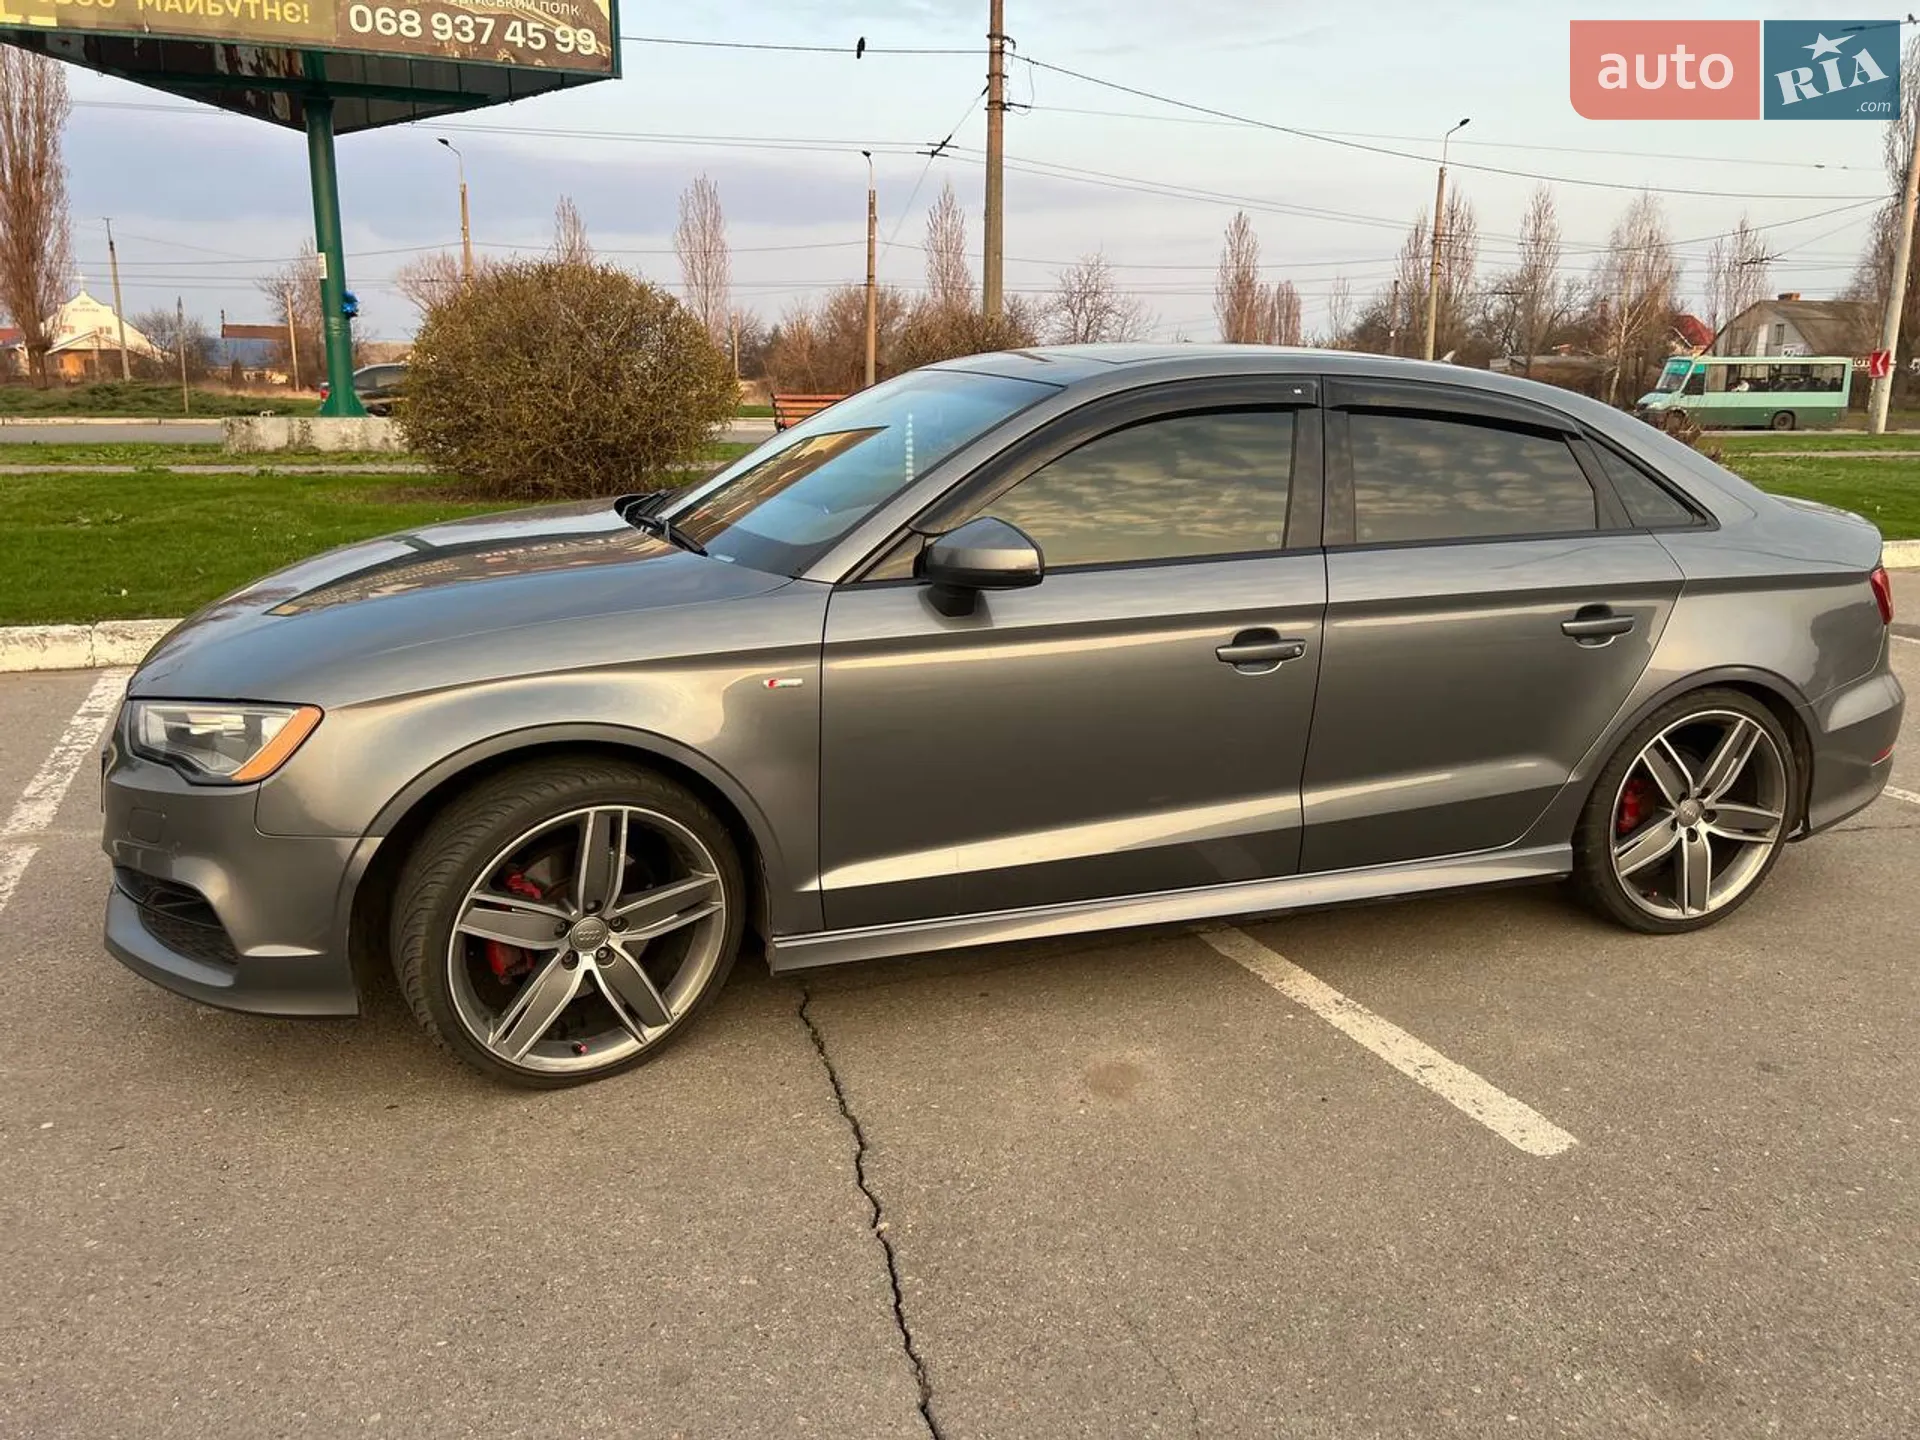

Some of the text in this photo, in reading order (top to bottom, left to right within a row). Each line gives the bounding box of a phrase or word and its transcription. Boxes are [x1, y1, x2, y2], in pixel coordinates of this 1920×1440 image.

[349, 4, 597, 56] 068 937 45 99
